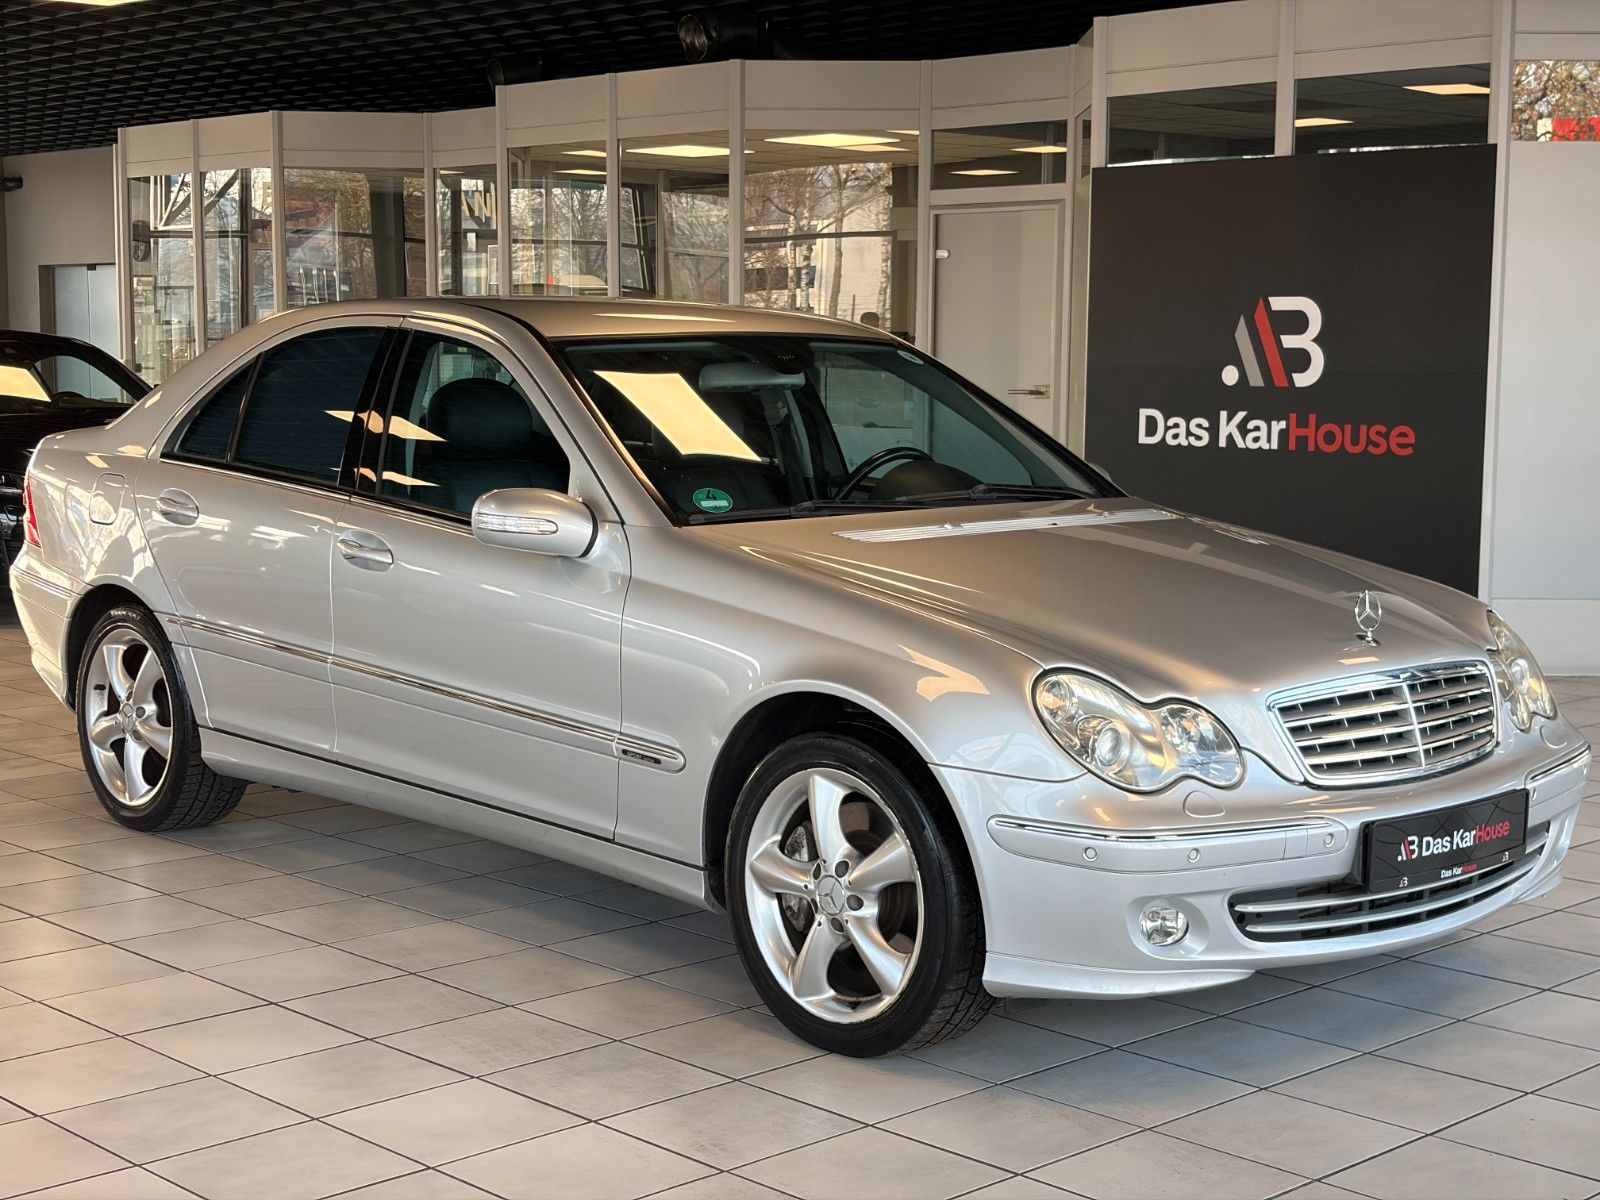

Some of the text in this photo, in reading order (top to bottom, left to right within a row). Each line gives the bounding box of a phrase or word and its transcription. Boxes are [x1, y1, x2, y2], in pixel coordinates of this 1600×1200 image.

[1138, 408, 1416, 456] Das KarHouse
[1421, 835, 1451, 857] Das
[1453, 820, 1510, 851] KarHouse
[1440, 869, 1453, 879] Das
